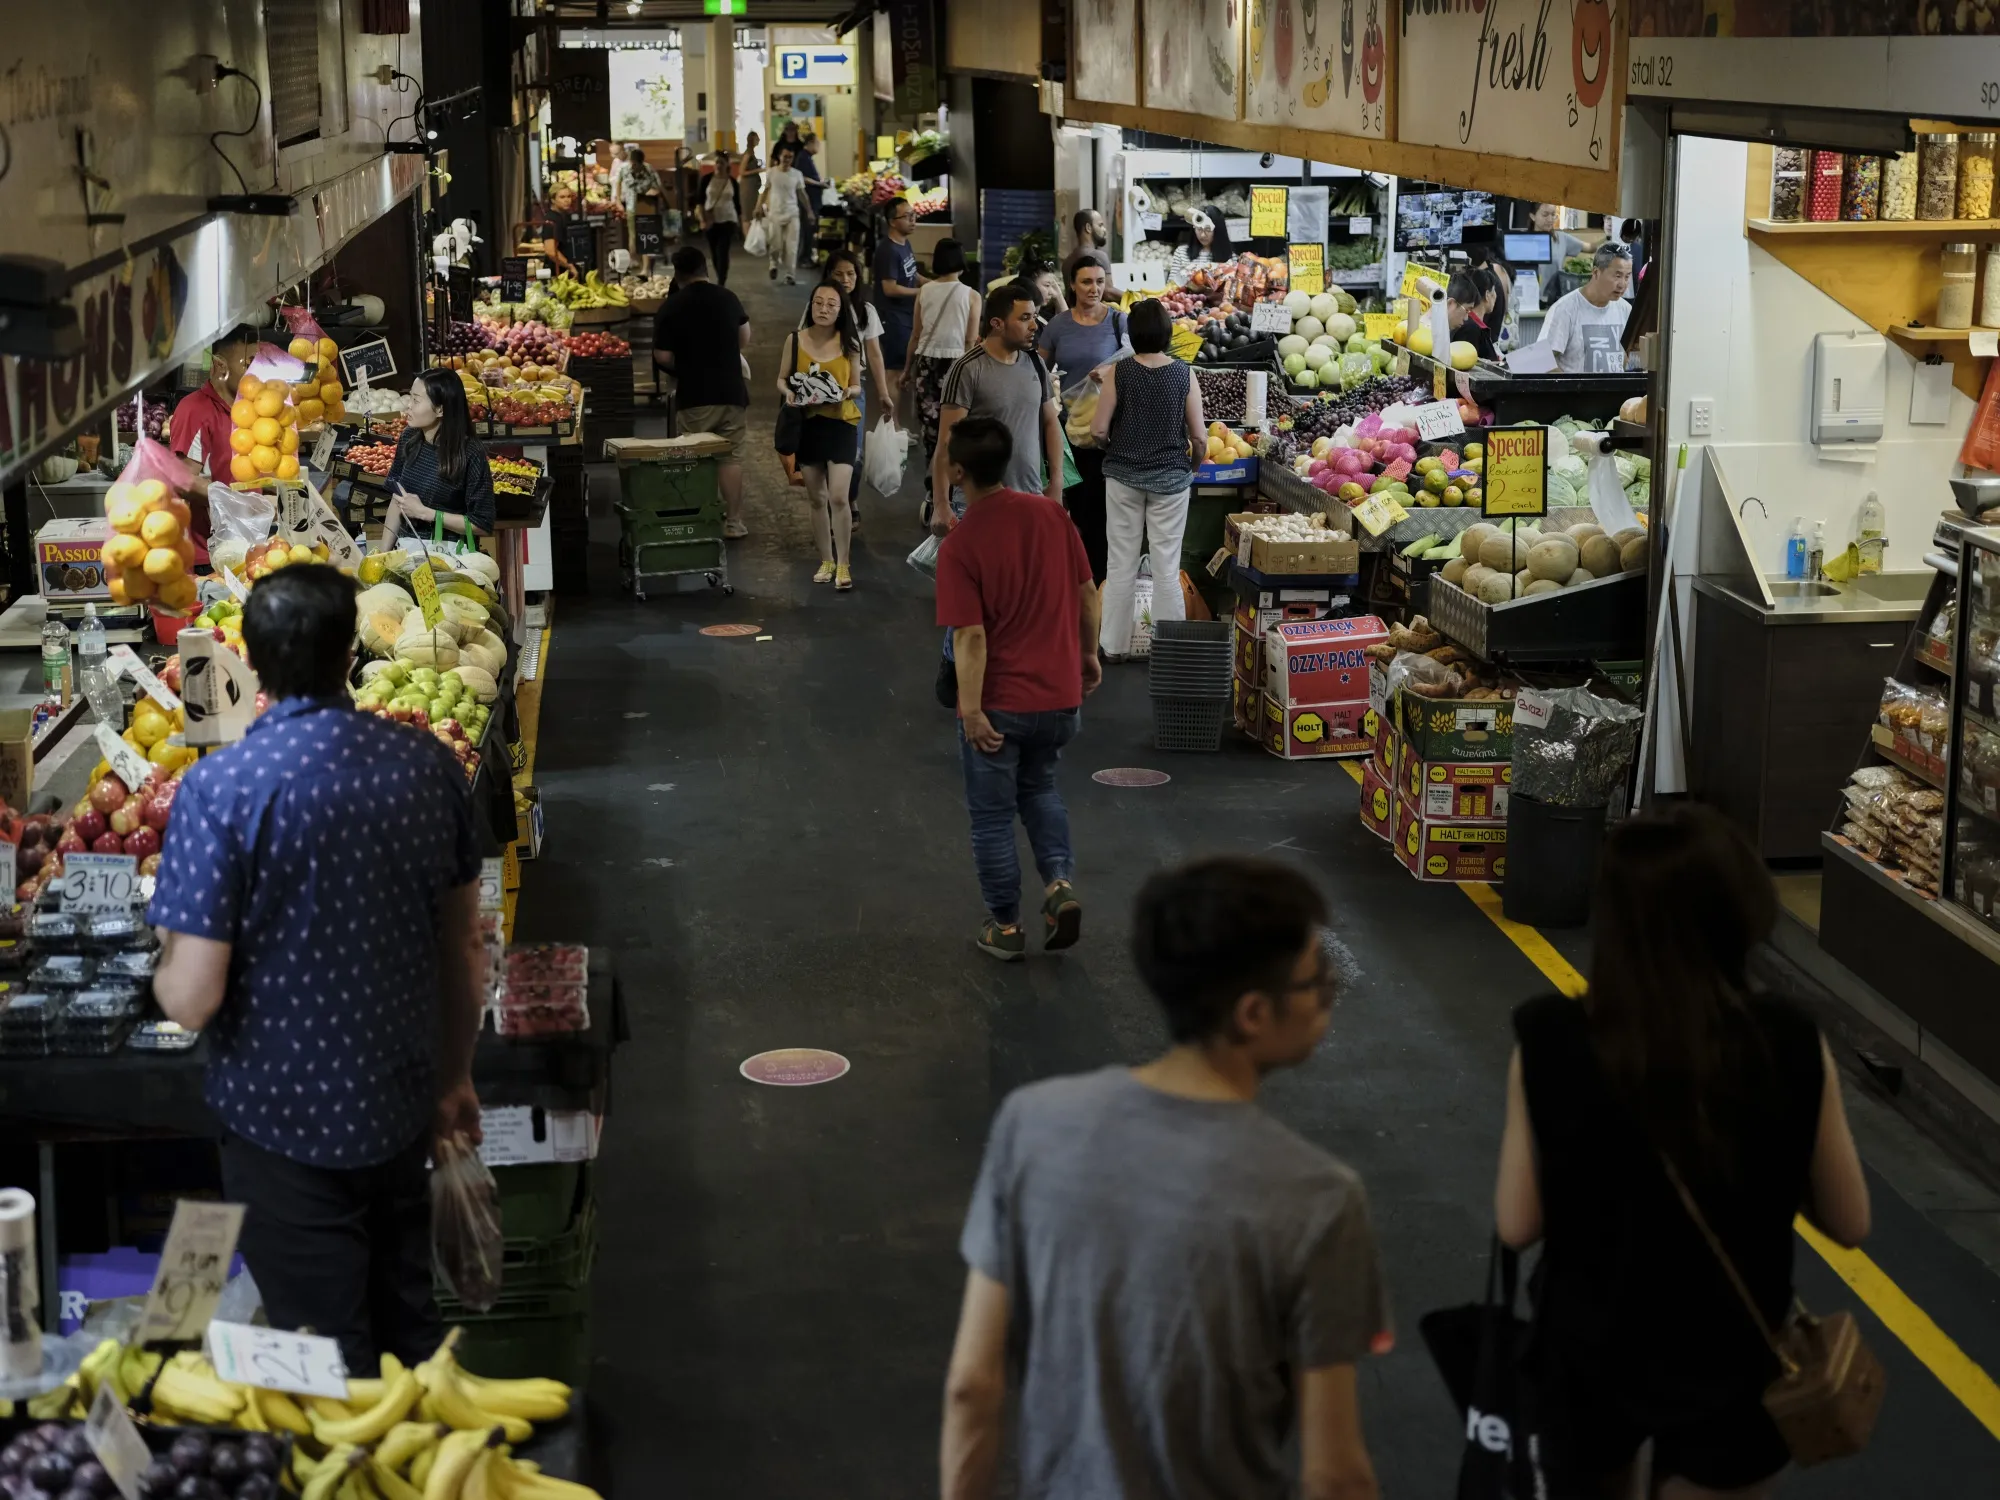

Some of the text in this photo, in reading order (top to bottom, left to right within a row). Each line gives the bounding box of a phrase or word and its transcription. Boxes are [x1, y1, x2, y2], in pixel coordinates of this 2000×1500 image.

[786, 54, 804, 77] P
[1459, 0, 1552, 144] fresh
[1632, 56, 1673, 86] stall 32
[1283, 620, 1357, 637] OZZY-PACK
[1288, 647, 1367, 675] OZZY-PACK
[1297, 723, 1321, 732] HOLT
[1440, 830, 1462, 840] HALT
[1477, 830, 1506, 841] HOLTS
